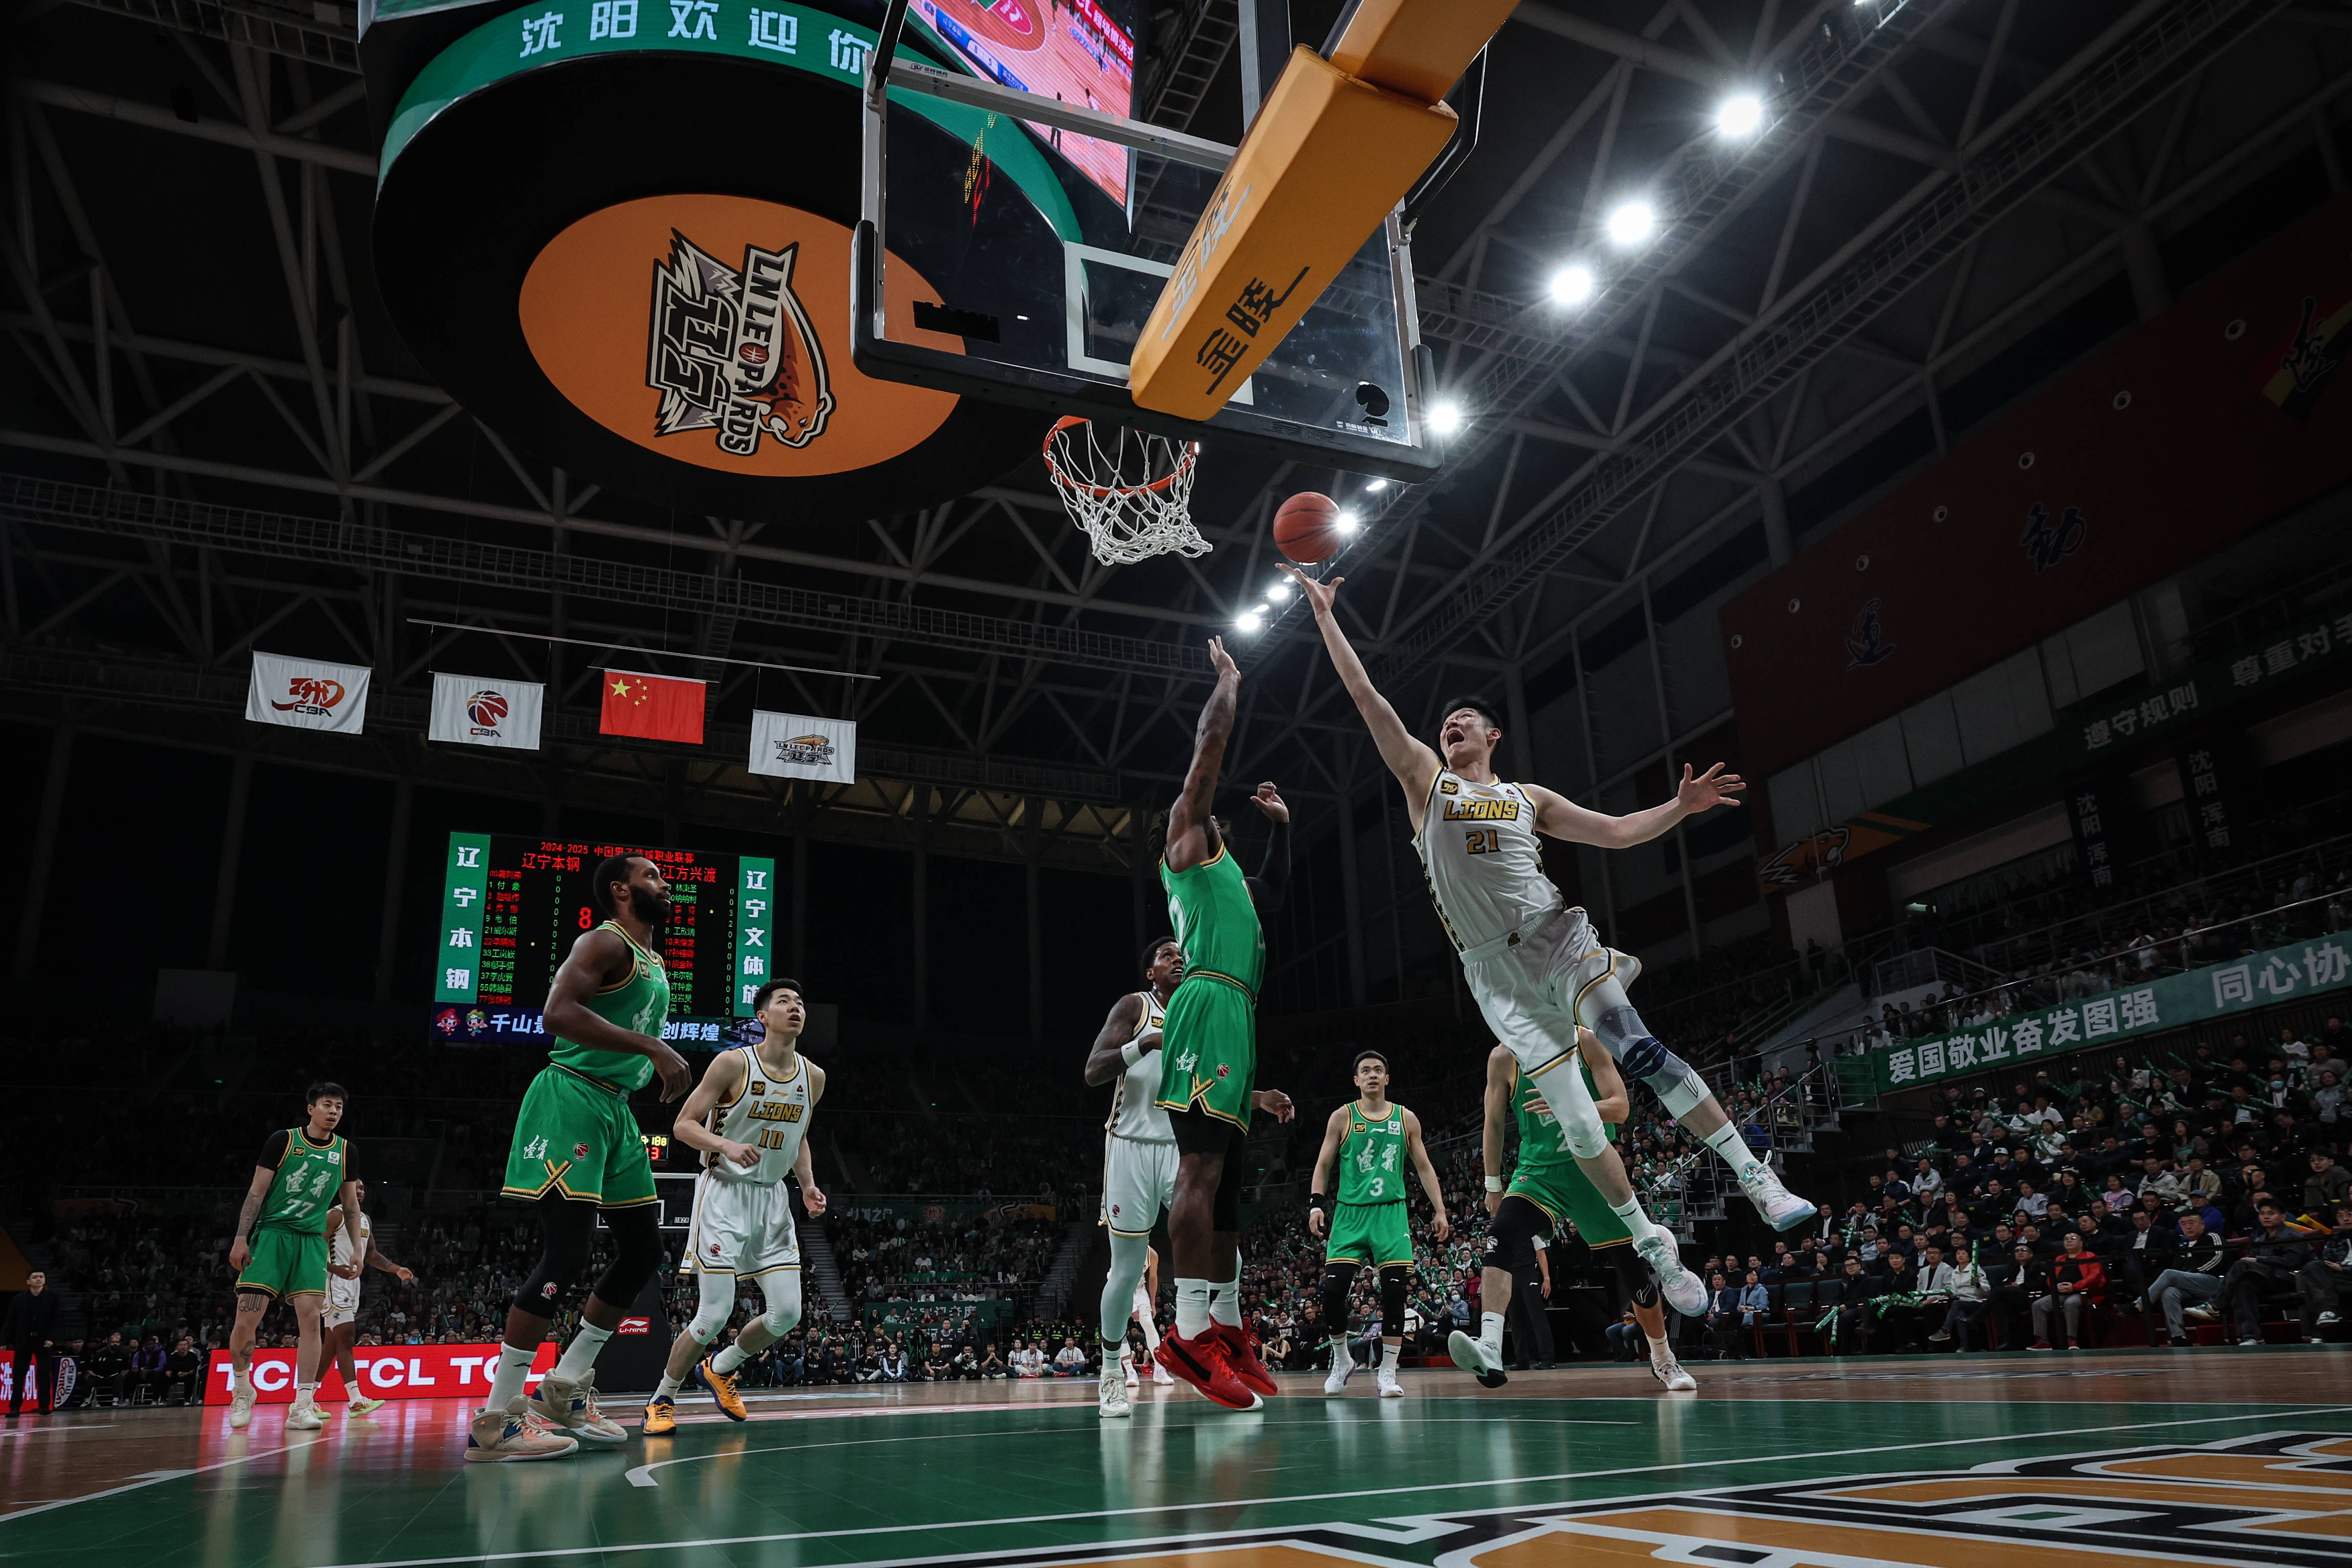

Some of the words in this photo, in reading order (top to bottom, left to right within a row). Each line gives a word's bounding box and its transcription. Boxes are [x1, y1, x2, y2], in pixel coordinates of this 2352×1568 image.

[519, 1, 875, 73] 沈阳欢迎你
[1197, 266, 1311, 395] 金陵
[294, 704, 332, 717] CBA
[2084, 681, 2199, 750] 遵守规则
[470, 727, 501, 738] CBA
[789, 745, 833, 754] LEOPARDS
[2188, 749, 2231, 848] 沈阳浑南
[1443, 800, 1519, 821] LIONS
[540, 842, 588, 854] 2024-2025
[1466, 829, 1501, 854] 21
[2076, 792, 2113, 888] 沈阳浑南
[521, 852, 581, 872] 辽宁本钢
[446, 846, 481, 990] 辽宁本钢
[578, 906, 592, 929] 8
[662, 1022, 720, 1041] 创辉煌
[1888, 988, 2159, 1085] 爱国敬业奋发图强
[748, 1100, 803, 1123] LIONS
[758, 1129, 784, 1150] 10
[1370, 1177, 1385, 1197] 3
[280, 1198, 316, 1219] 77
[0, 1361, 37, 1401] 洗机
